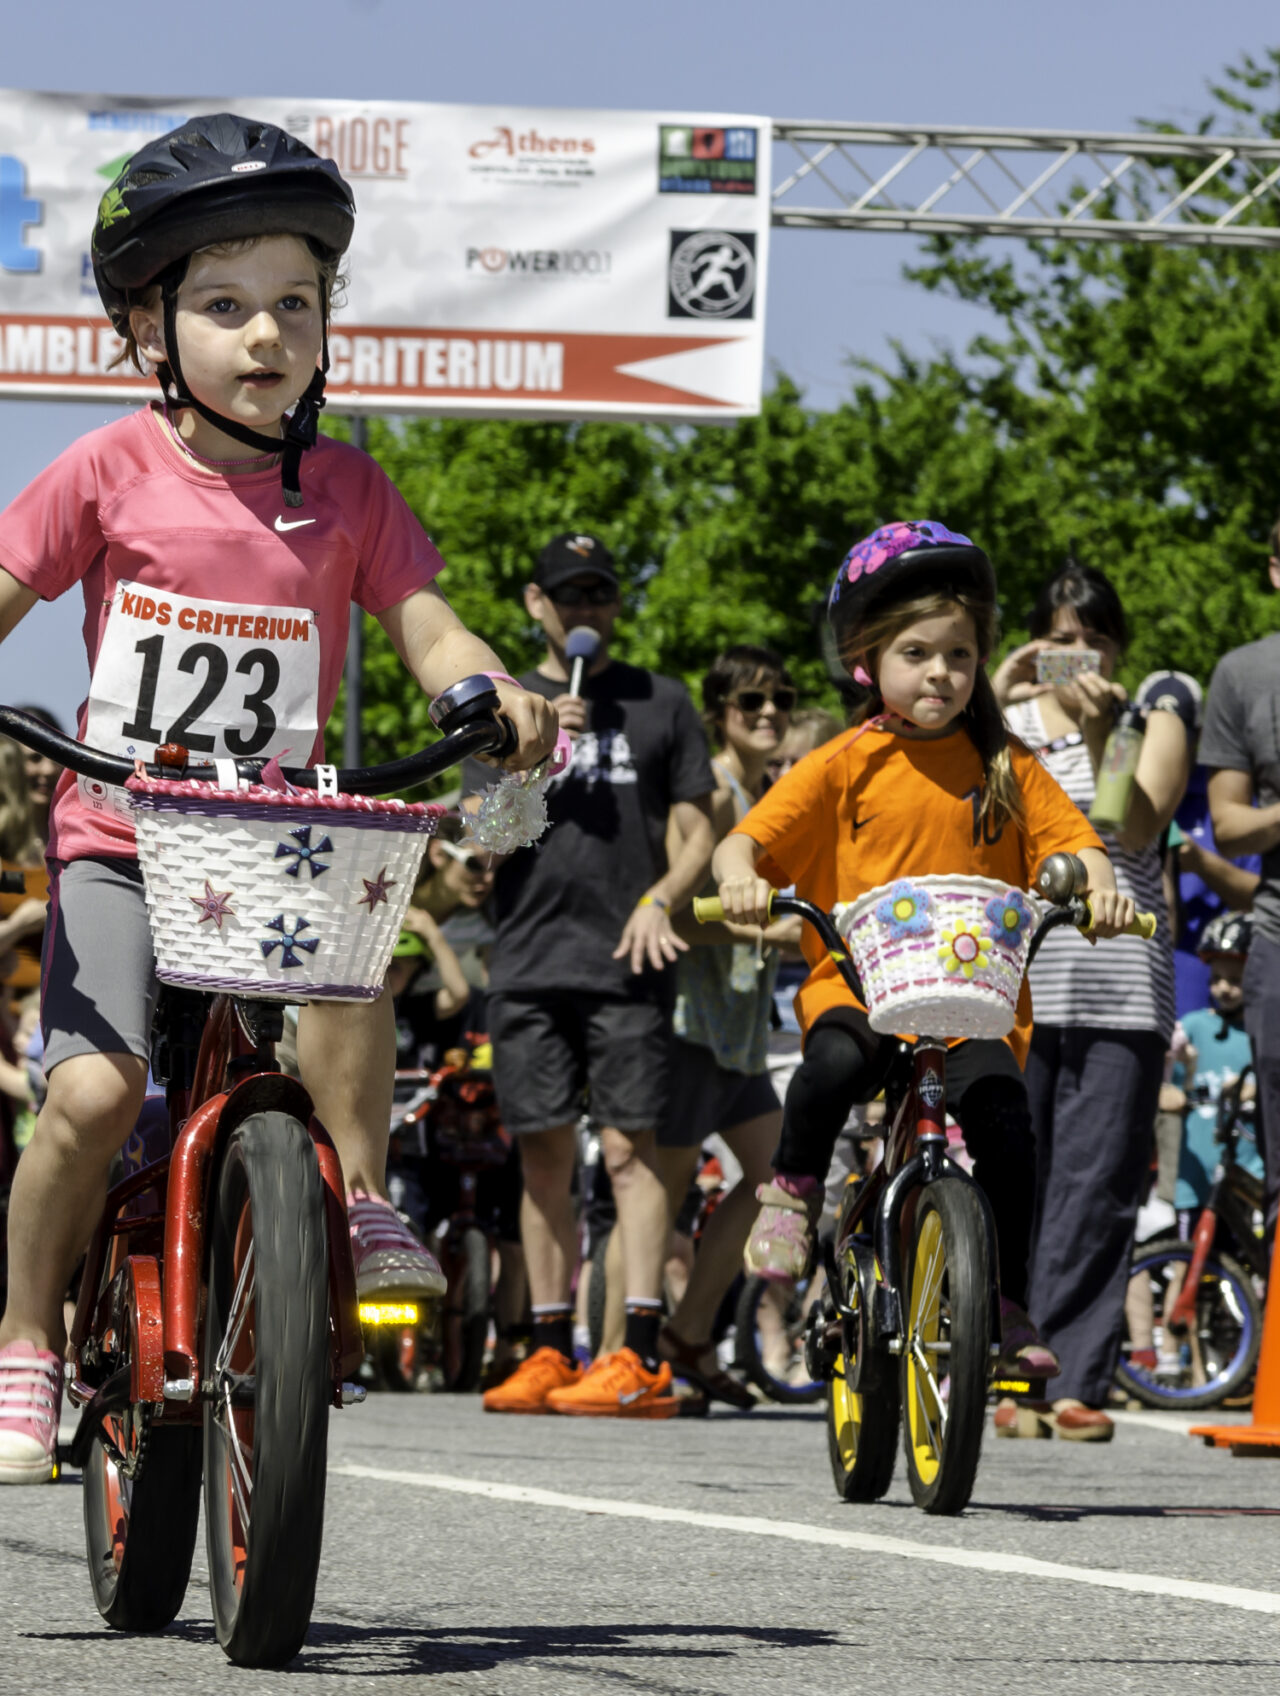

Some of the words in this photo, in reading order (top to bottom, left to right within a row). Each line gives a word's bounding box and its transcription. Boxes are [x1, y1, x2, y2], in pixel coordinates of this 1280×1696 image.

[316, 116, 410, 174] RIDGE
[469, 126, 596, 157] Athens
[327, 334, 565, 392] CRITERIUM
[121, 592, 171, 626] KIDS
[178, 607, 309, 642] CRITERIUM
[122, 634, 281, 756] 123
